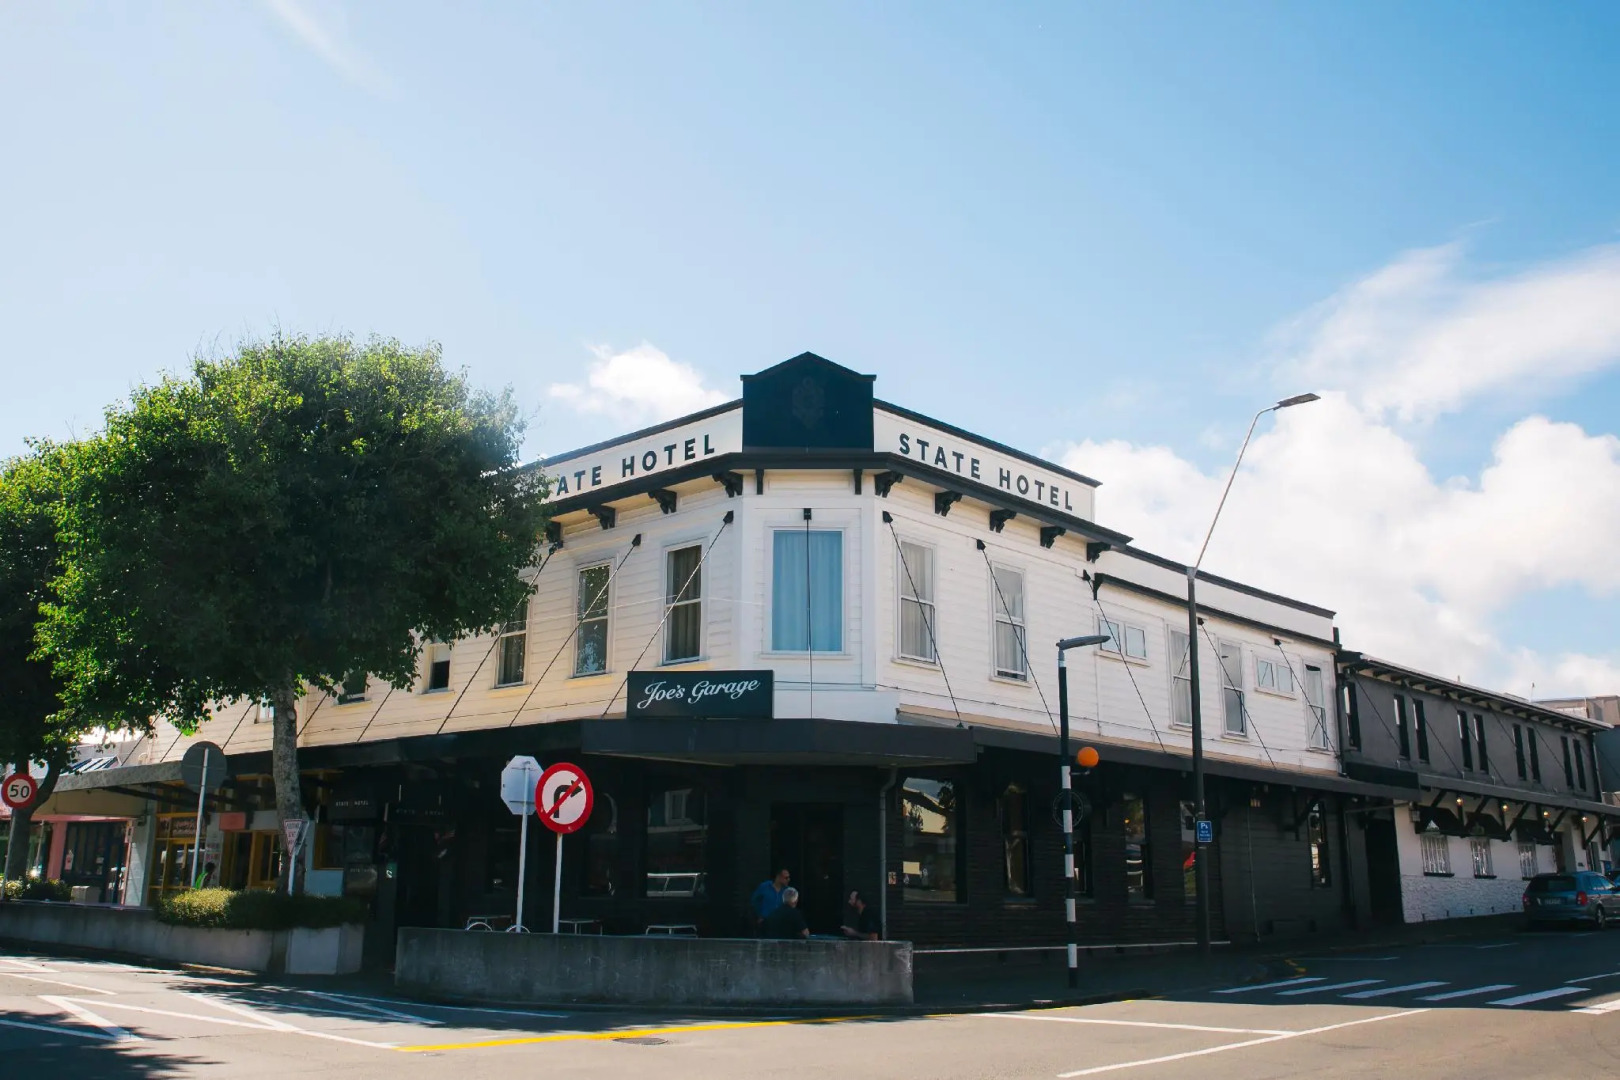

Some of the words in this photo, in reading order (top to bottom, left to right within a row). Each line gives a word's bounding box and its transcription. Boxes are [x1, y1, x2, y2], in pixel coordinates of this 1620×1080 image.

[556, 465, 602, 496] ATE
[621, 434, 715, 478] HOTEL
[899, 433, 981, 480] STATE
[999, 467, 1073, 511] HOTEL
[636, 681, 686, 709] Joe's
[687, 679, 761, 704] Garage
[9, 784, 30, 798] 50
